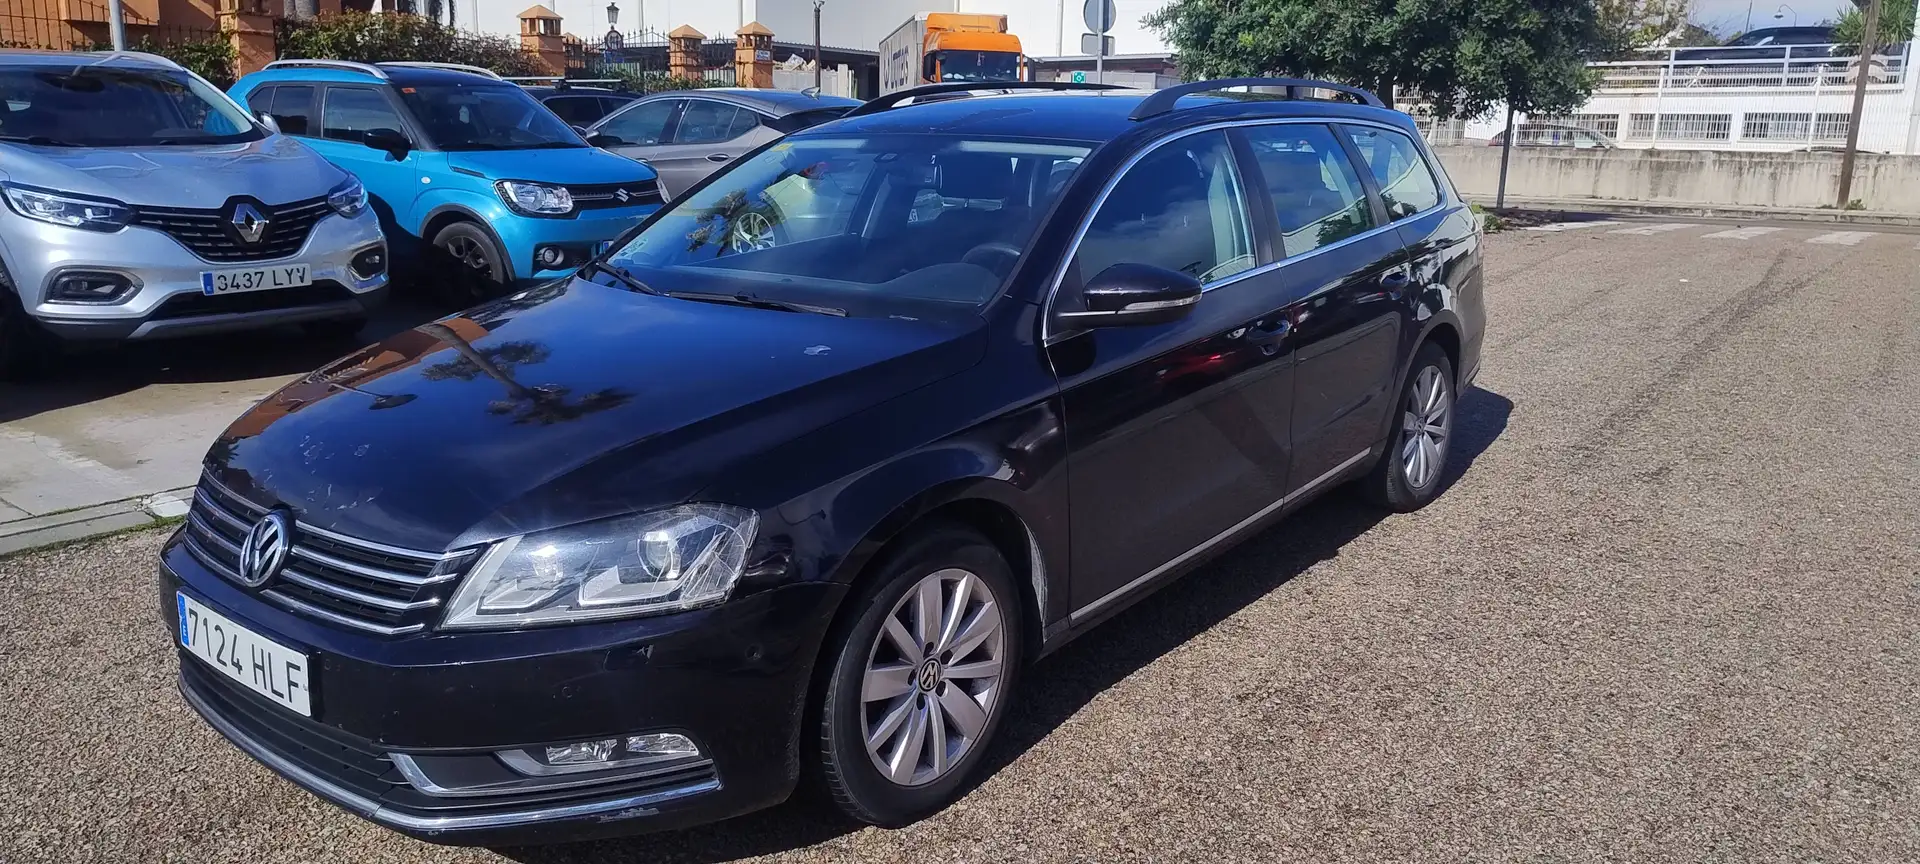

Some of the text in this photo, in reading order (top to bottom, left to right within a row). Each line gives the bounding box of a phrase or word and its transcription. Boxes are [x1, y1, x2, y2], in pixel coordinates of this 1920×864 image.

[217, 267, 306, 291] 3437 LYV
[188, 607, 243, 675] 7124
[251, 643, 301, 703] HLF
